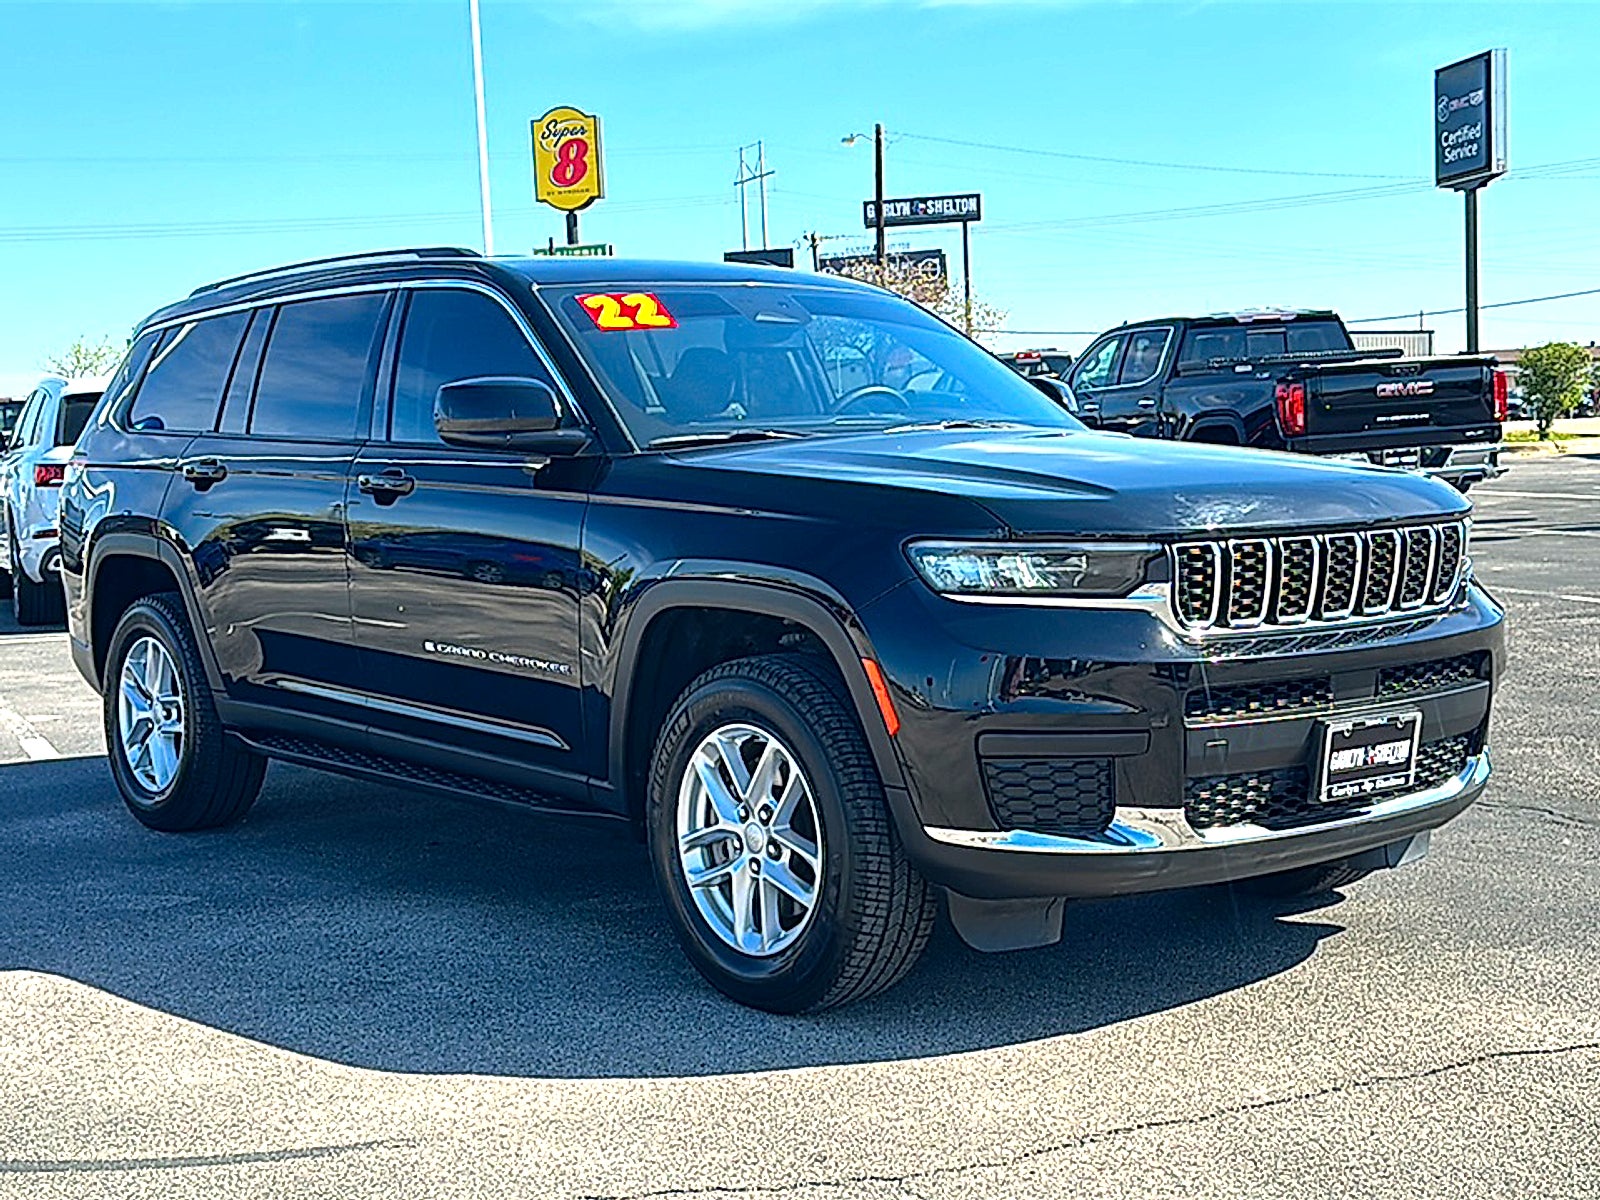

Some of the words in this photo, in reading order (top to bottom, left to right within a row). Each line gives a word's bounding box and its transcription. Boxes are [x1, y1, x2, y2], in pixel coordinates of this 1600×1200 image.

[541, 118, 588, 148] Super
[1441, 121, 1481, 147] Certified
[550, 138, 589, 188] 8
[1444, 141, 1478, 163] Service
[866, 201, 911, 218] GRLYN
[926, 197, 977, 214] SHELTON
[583, 293, 671, 328] 22
[1376, 381, 1434, 397] GMC
[437, 643, 486, 659] GRAND
[489, 652, 572, 675] CHEROKEE
